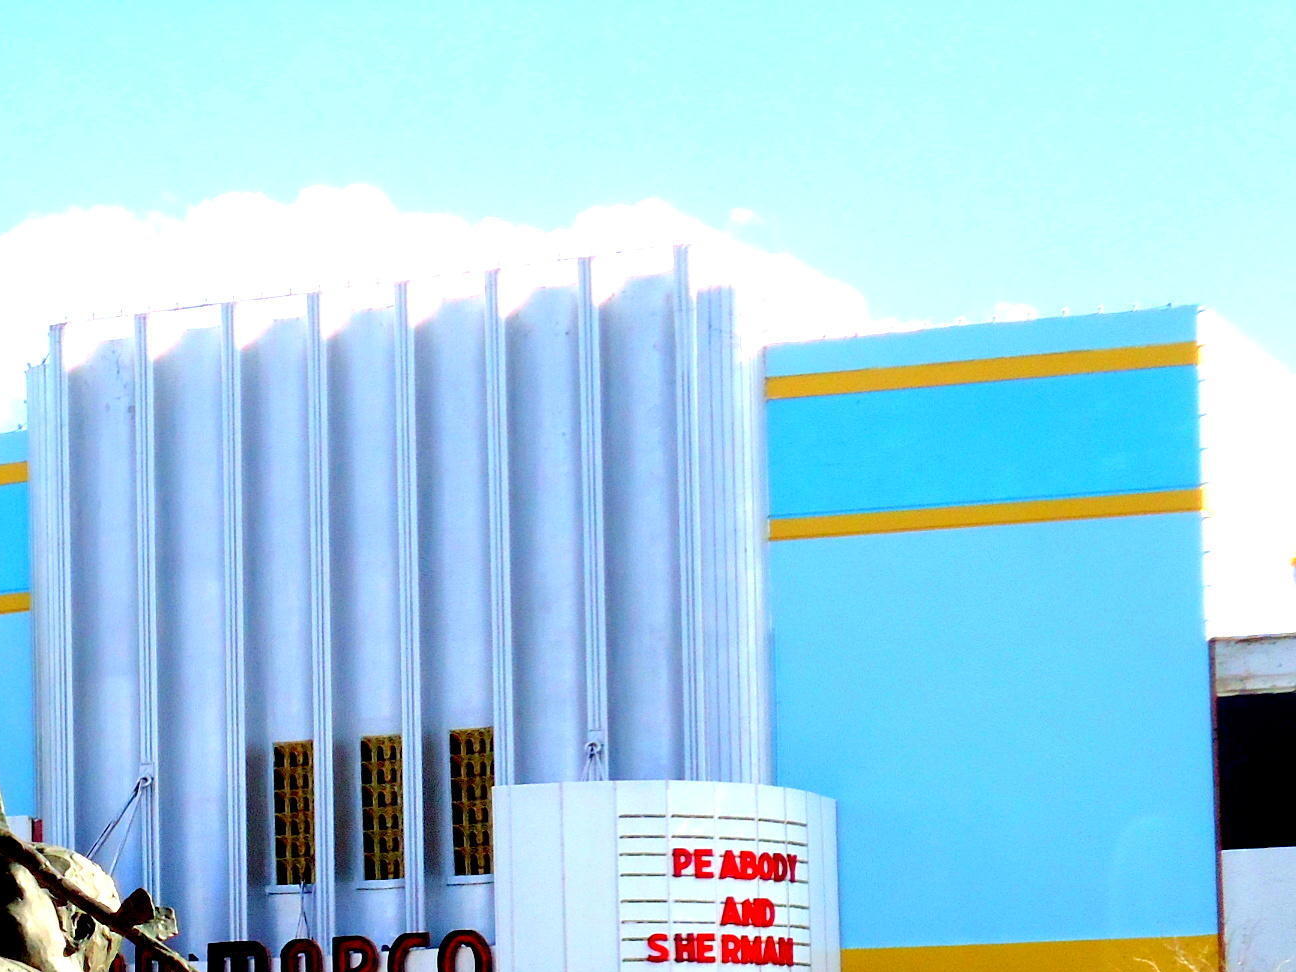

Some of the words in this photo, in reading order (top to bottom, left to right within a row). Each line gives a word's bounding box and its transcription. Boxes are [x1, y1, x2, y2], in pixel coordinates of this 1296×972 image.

[671, 848, 798, 883] PEABODY
[720, 896, 776, 928] AND
[646, 933, 795, 967] SHERMAN
